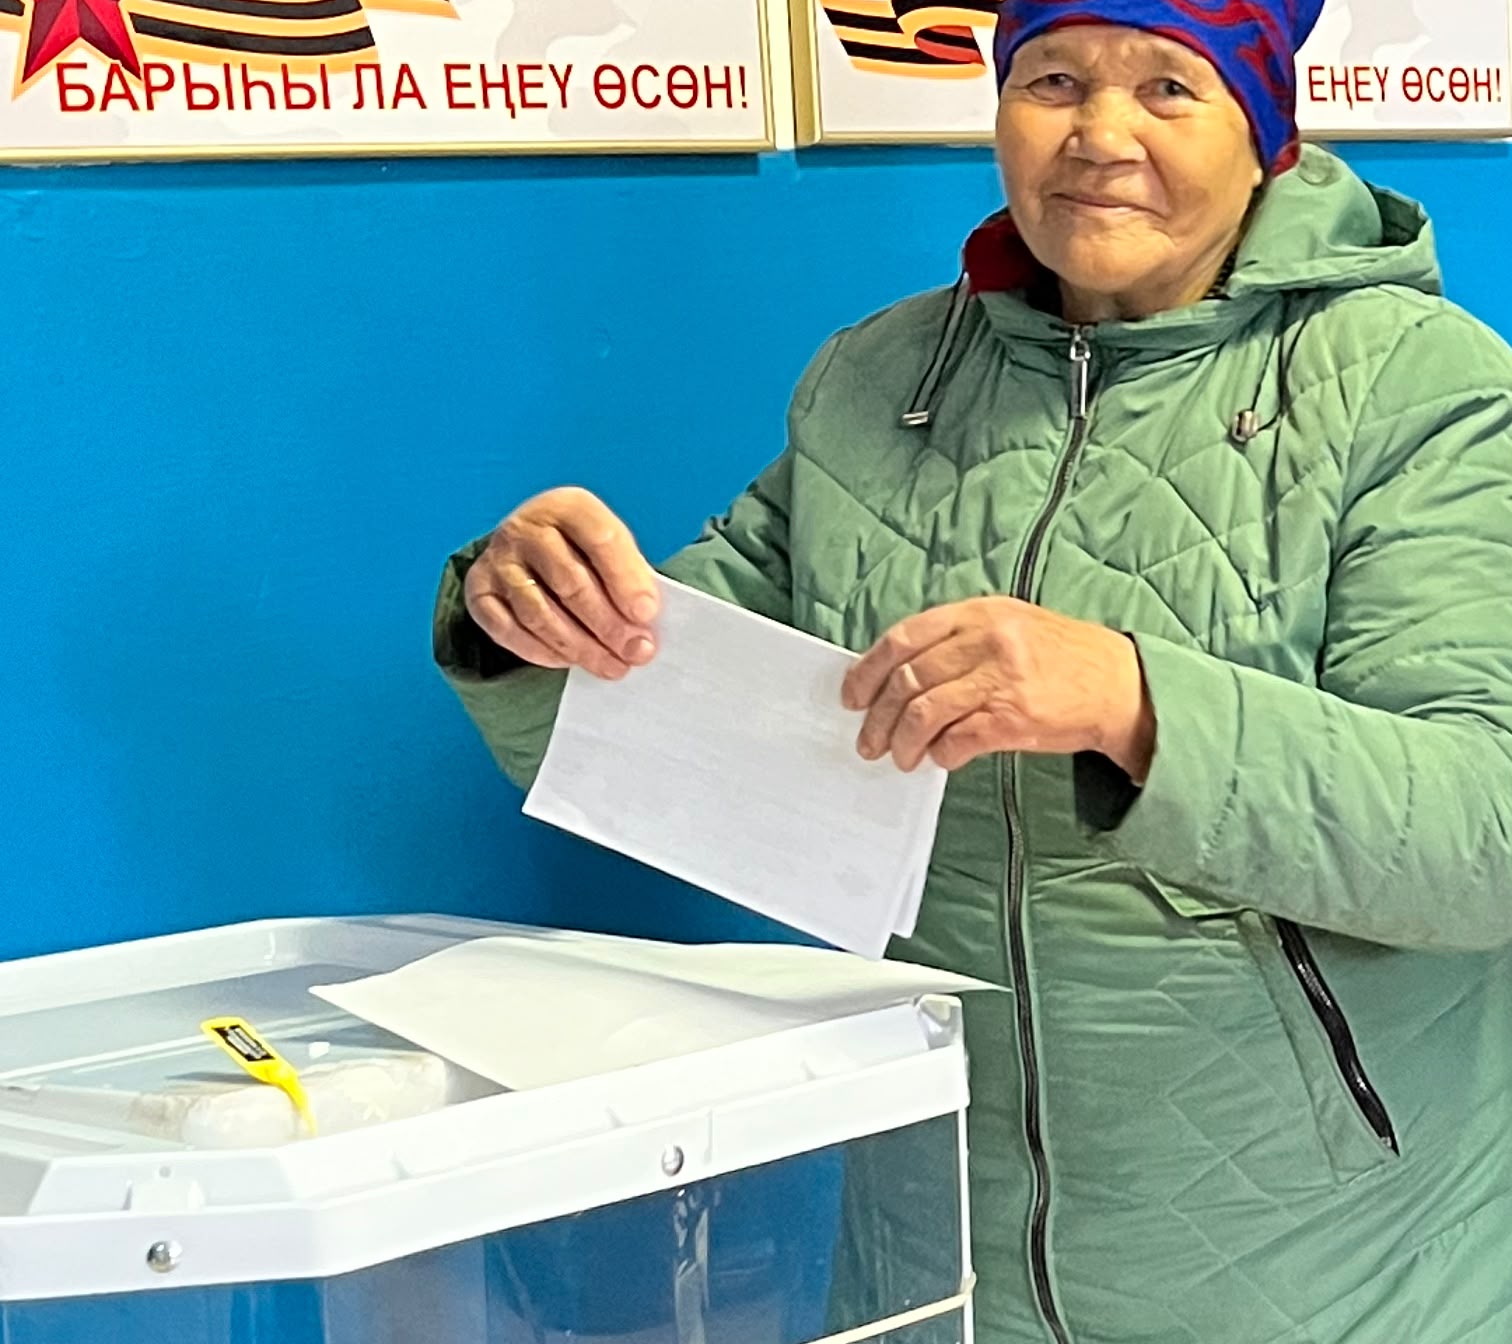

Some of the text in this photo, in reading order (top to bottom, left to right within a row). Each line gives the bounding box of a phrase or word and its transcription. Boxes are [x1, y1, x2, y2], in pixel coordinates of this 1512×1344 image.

[352, 64, 428, 111] ЛА
[592, 63, 750, 110] ӨСӨН!
[1402, 67, 1501, 103] ӨСӨН!
